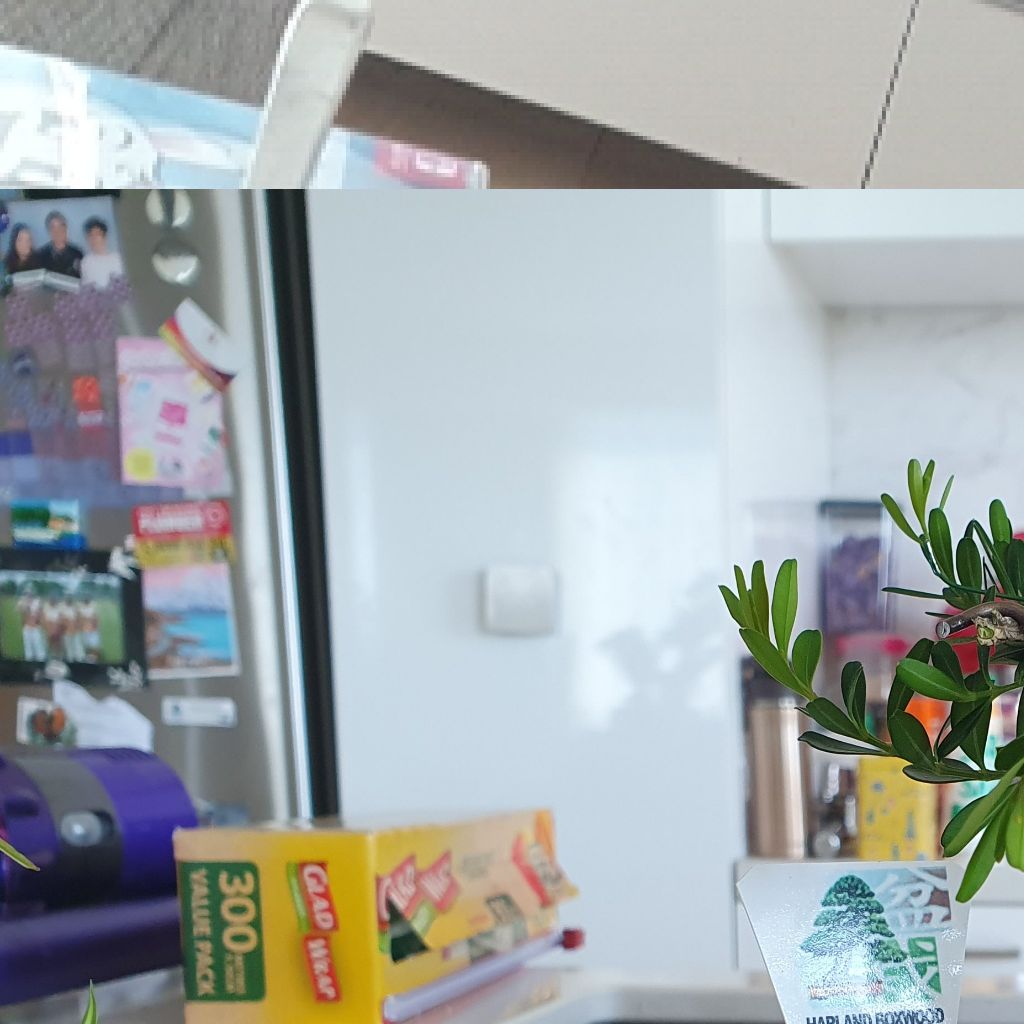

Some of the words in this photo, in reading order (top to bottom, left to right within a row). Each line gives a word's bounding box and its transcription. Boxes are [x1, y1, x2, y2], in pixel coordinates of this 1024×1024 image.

[190, 868, 211, 937] VALUE
[218, 870, 258, 953] 300
[303, 864, 334, 930] GLAD
[195, 940, 216, 997] PACK
[308, 938, 337, 1000] WRAP
